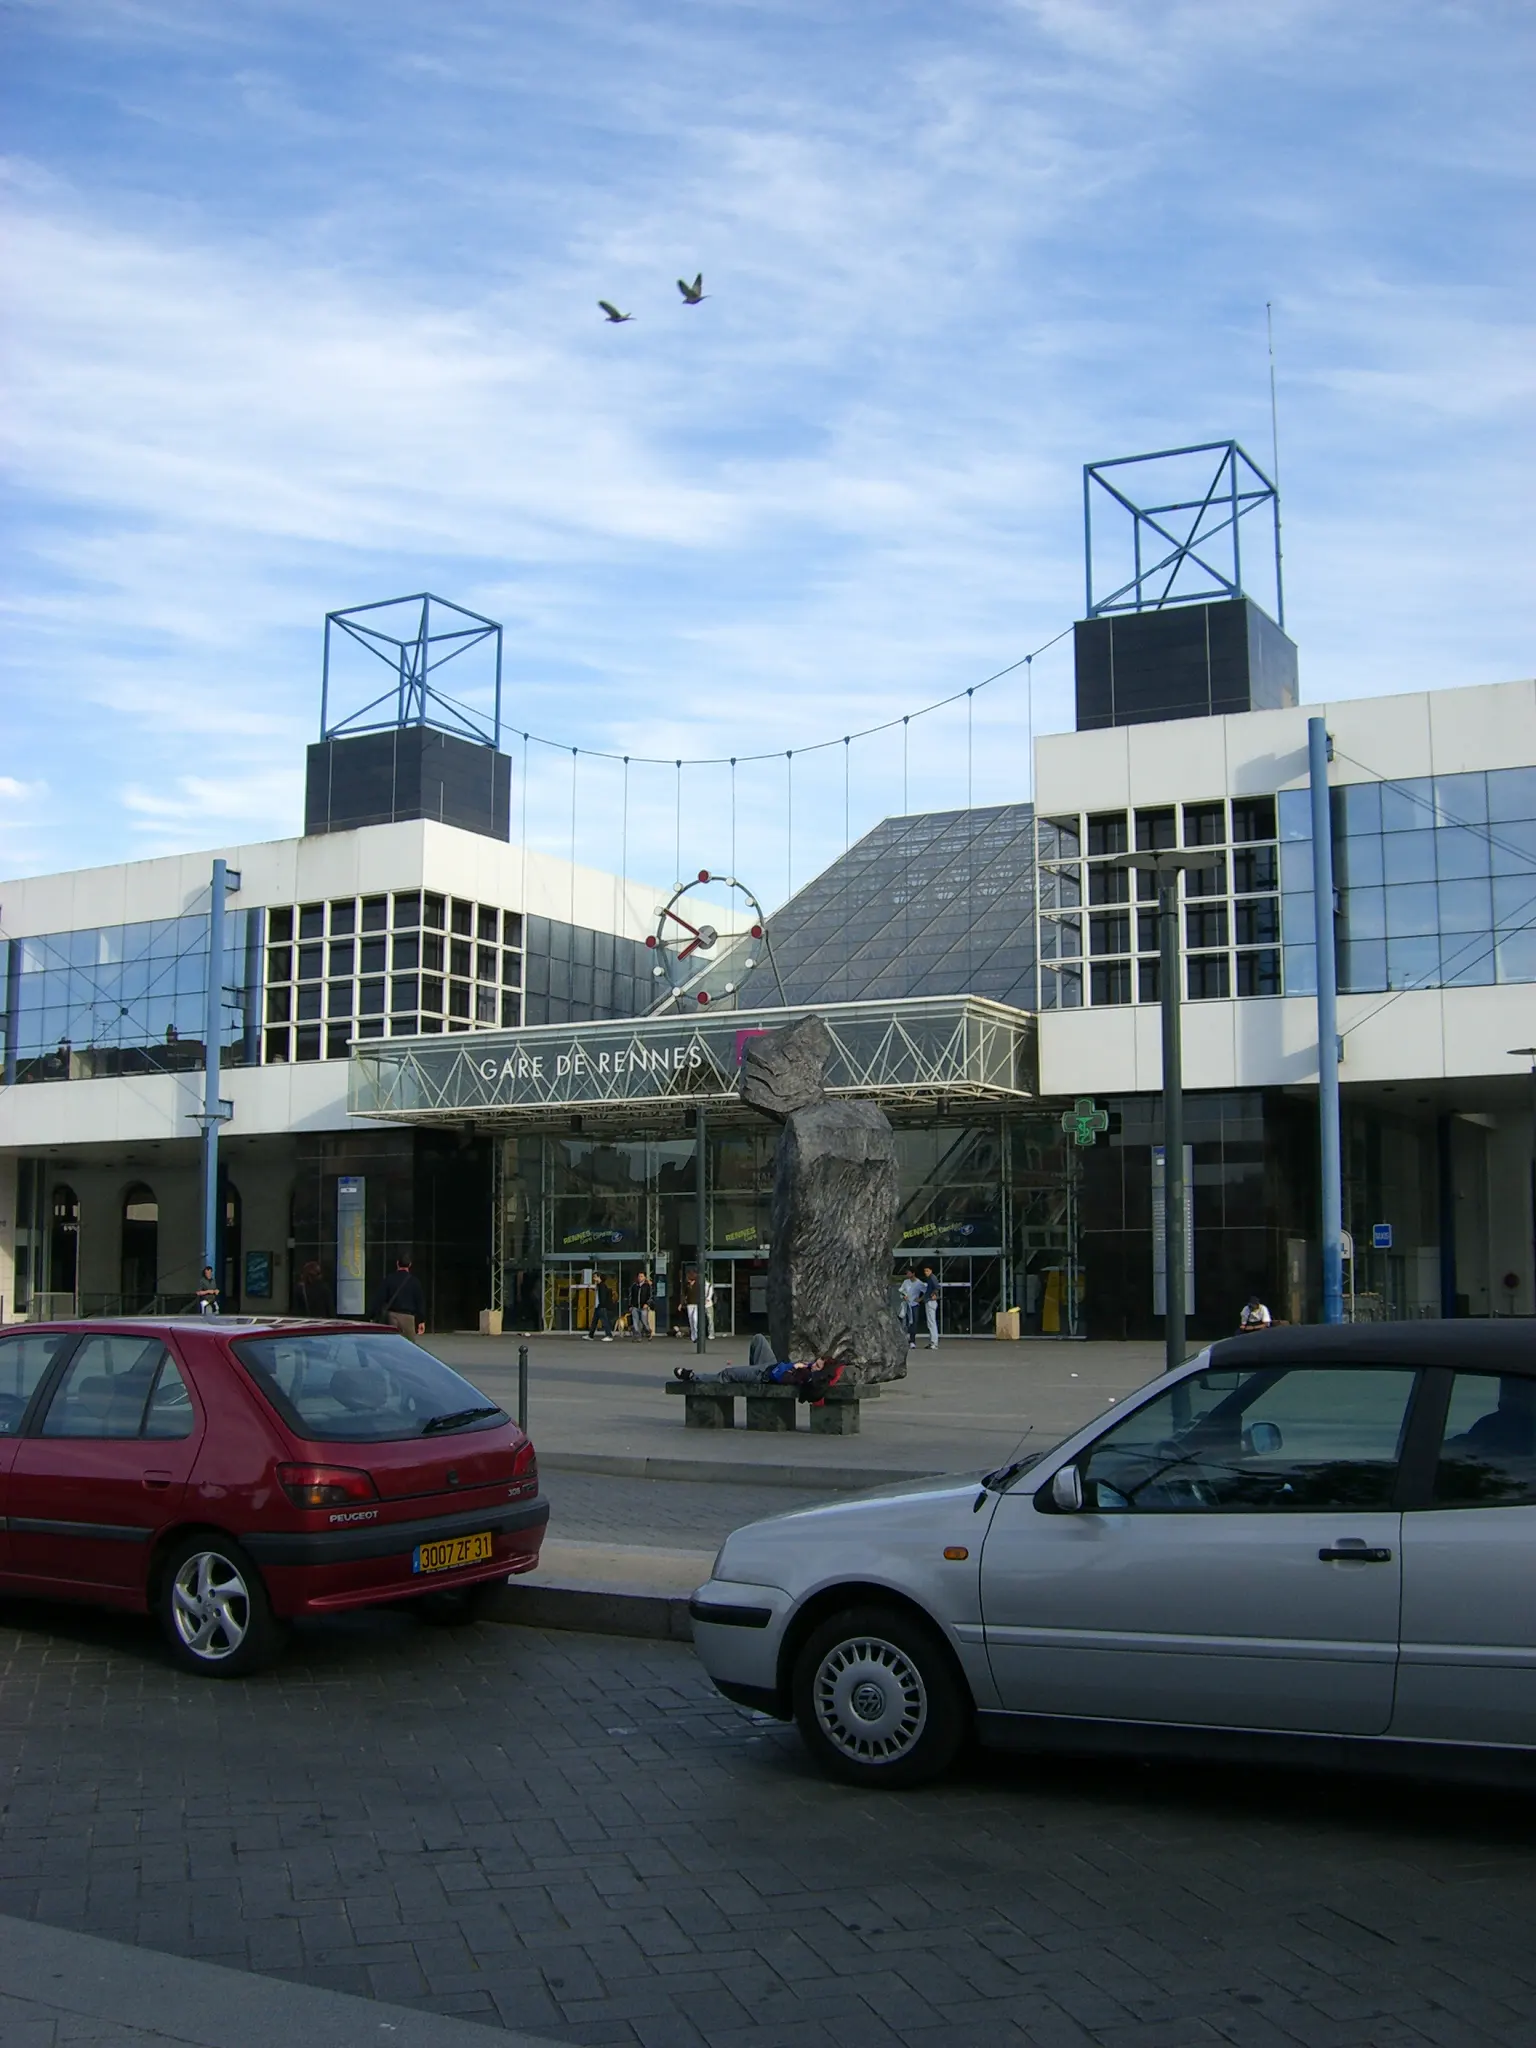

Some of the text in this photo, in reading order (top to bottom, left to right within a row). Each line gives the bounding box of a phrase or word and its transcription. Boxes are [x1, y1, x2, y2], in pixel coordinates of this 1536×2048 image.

[479, 1045, 702, 1081] GARE DE RENNES
[563, 1230, 591, 1245] RENNES
[725, 1226, 756, 1242] RENNES
[902, 1222, 937, 1239] RENNES
[329, 1510, 379, 1523] PEUGEOT
[421, 1543, 454, 1569] 3007
[457, 1540, 472, 1561] ZF
[474, 1536, 489, 1558] 31
